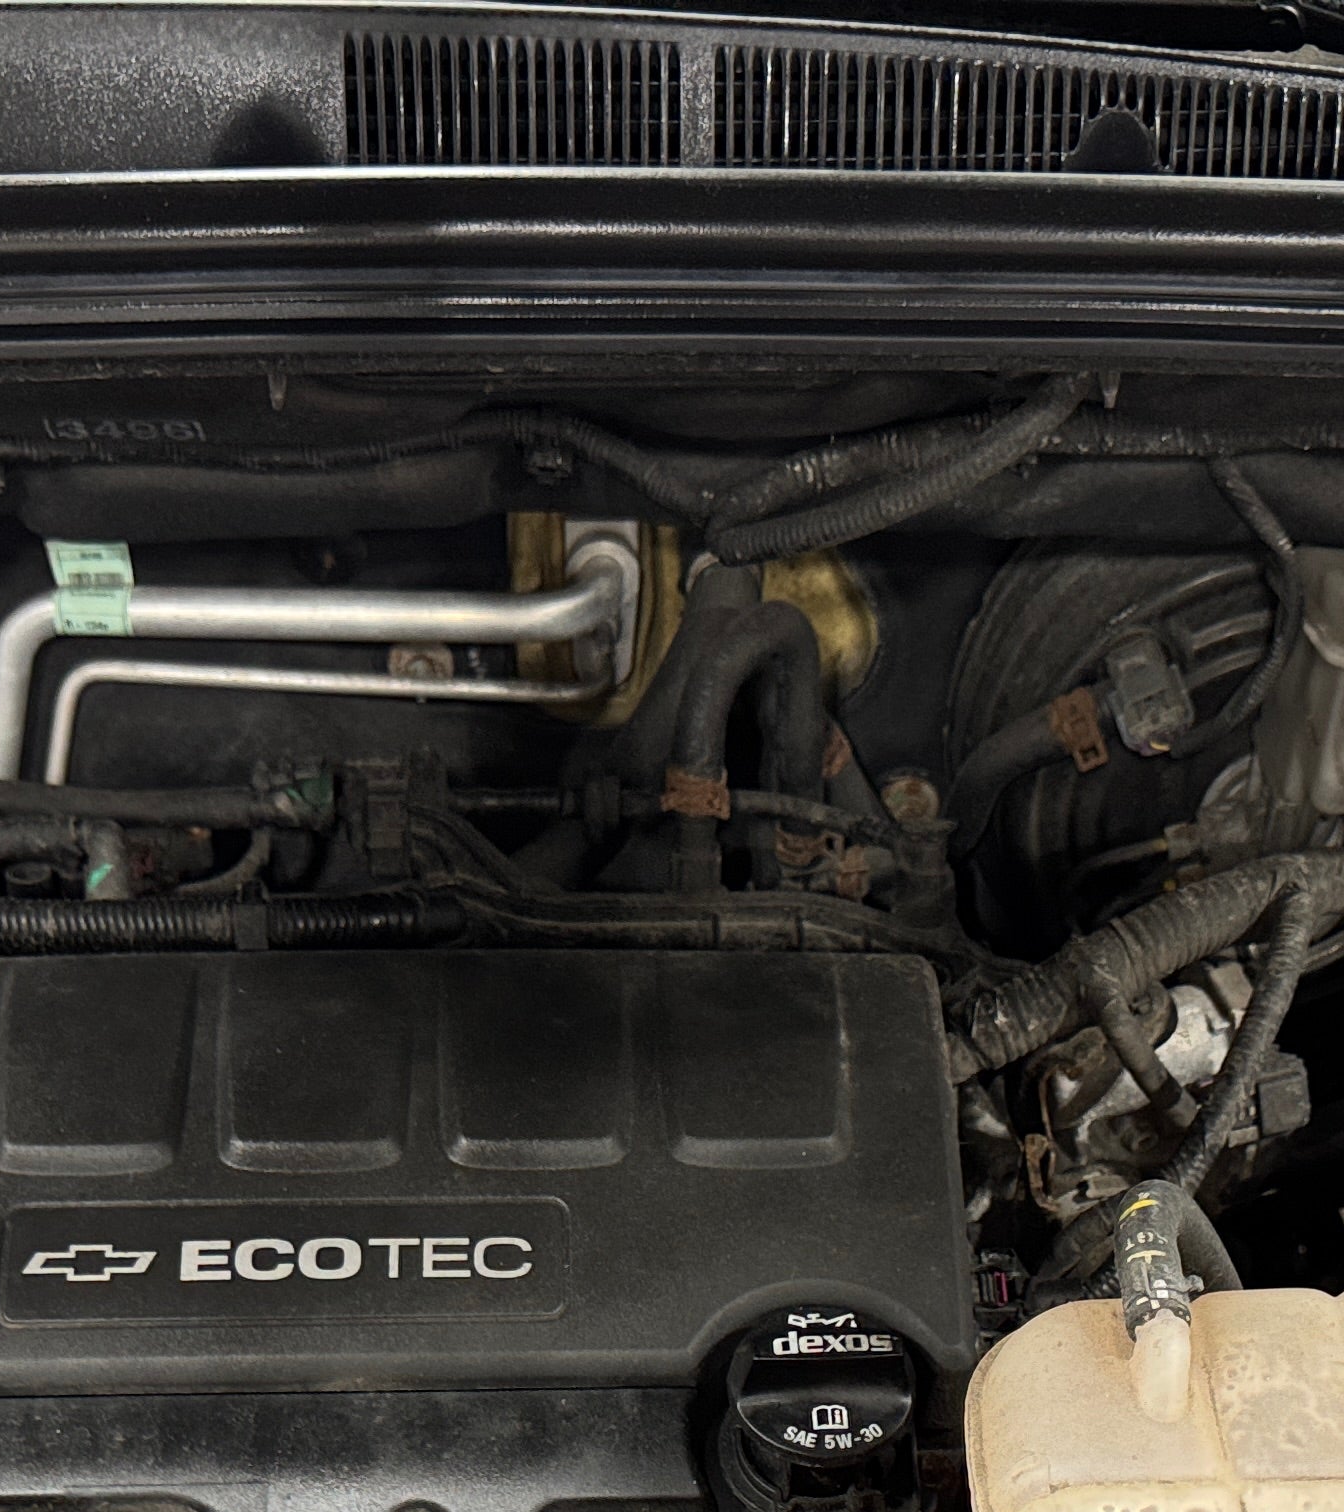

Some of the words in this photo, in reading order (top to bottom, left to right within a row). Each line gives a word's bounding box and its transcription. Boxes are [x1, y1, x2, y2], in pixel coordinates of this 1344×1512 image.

[179, 1236, 533, 1282] ECOTEC
[772, 1331, 893, 1356] dexos
[783, 1425, 818, 1448] SAE
[824, 1423, 884, 1449] 5W-30
